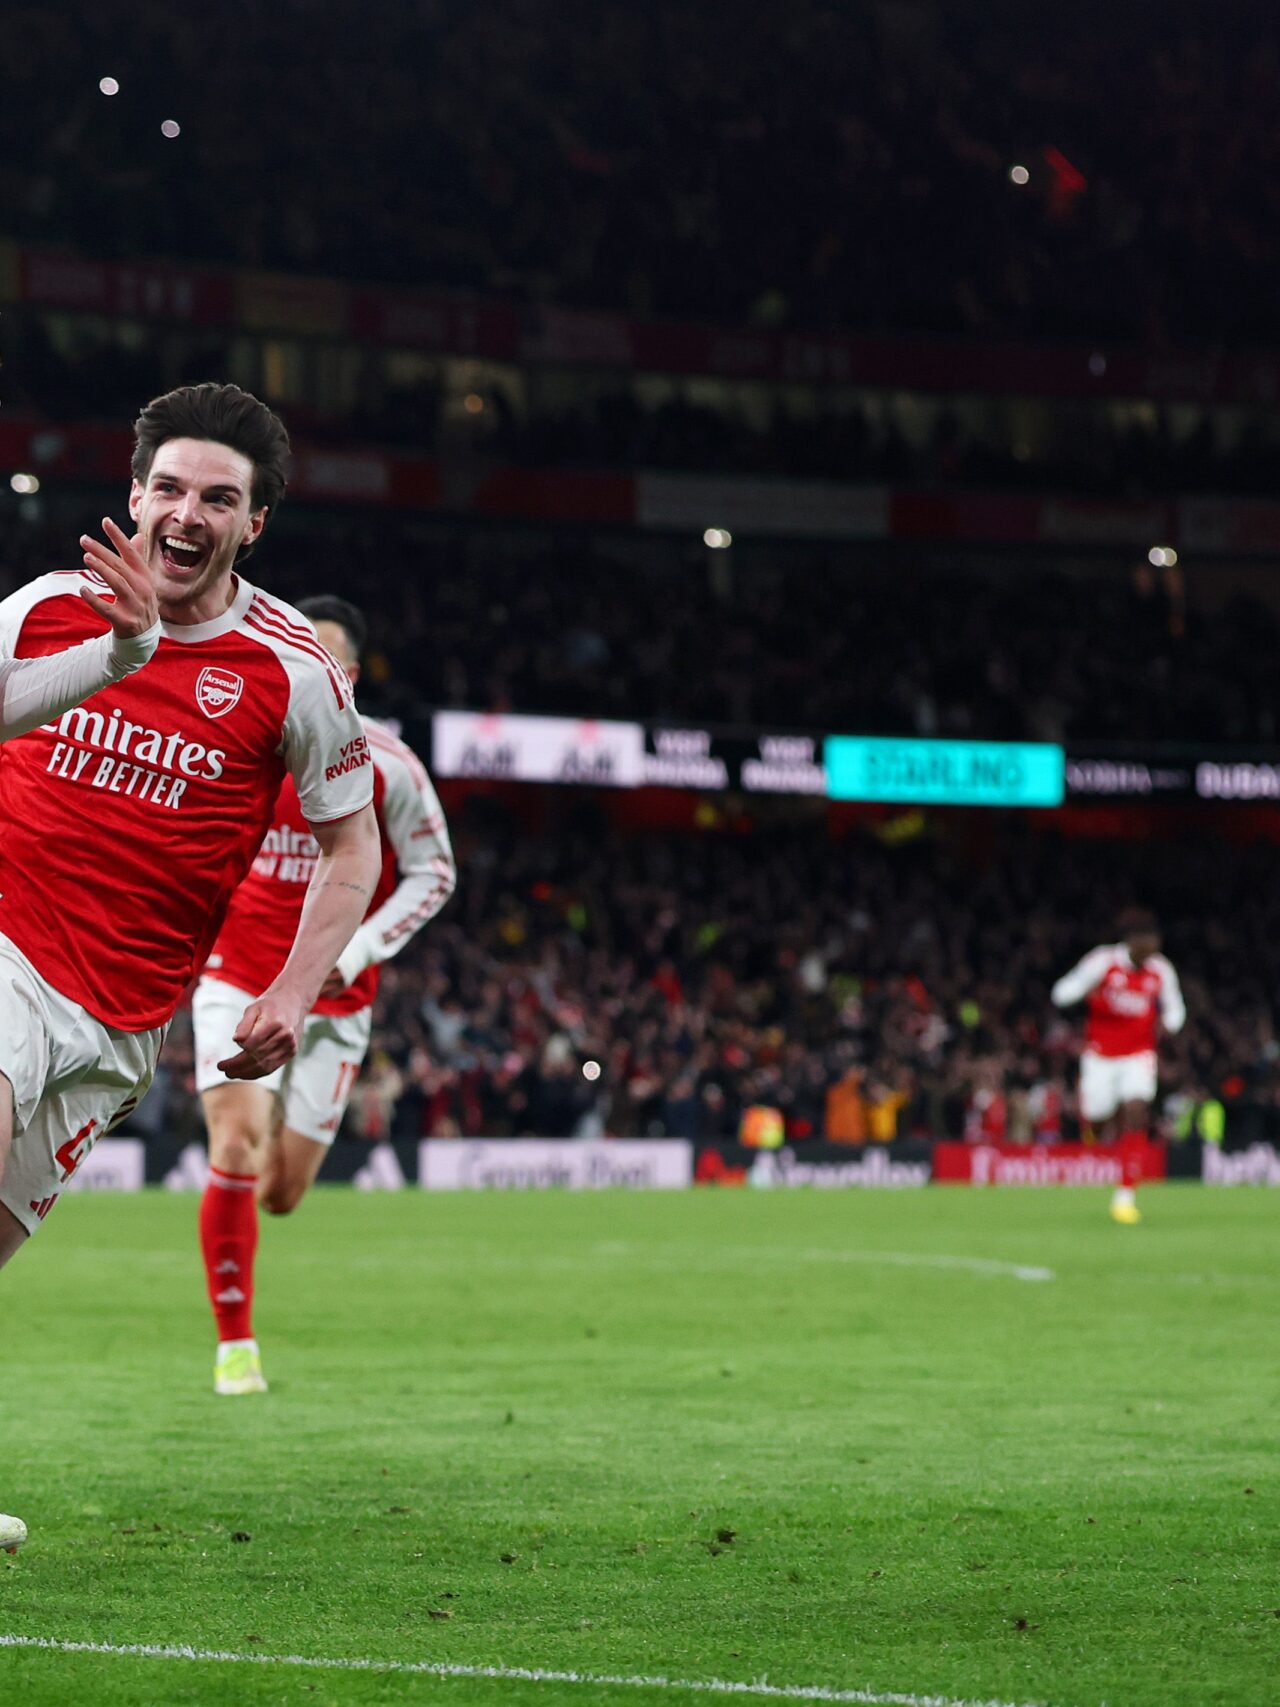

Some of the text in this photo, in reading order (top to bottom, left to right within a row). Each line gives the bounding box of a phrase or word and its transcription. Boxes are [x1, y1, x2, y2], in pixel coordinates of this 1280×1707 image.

[205, 674, 237, 690] Arsenal
[40, 706, 226, 781] mirates
[46, 741, 188, 810] FLY BETTER
